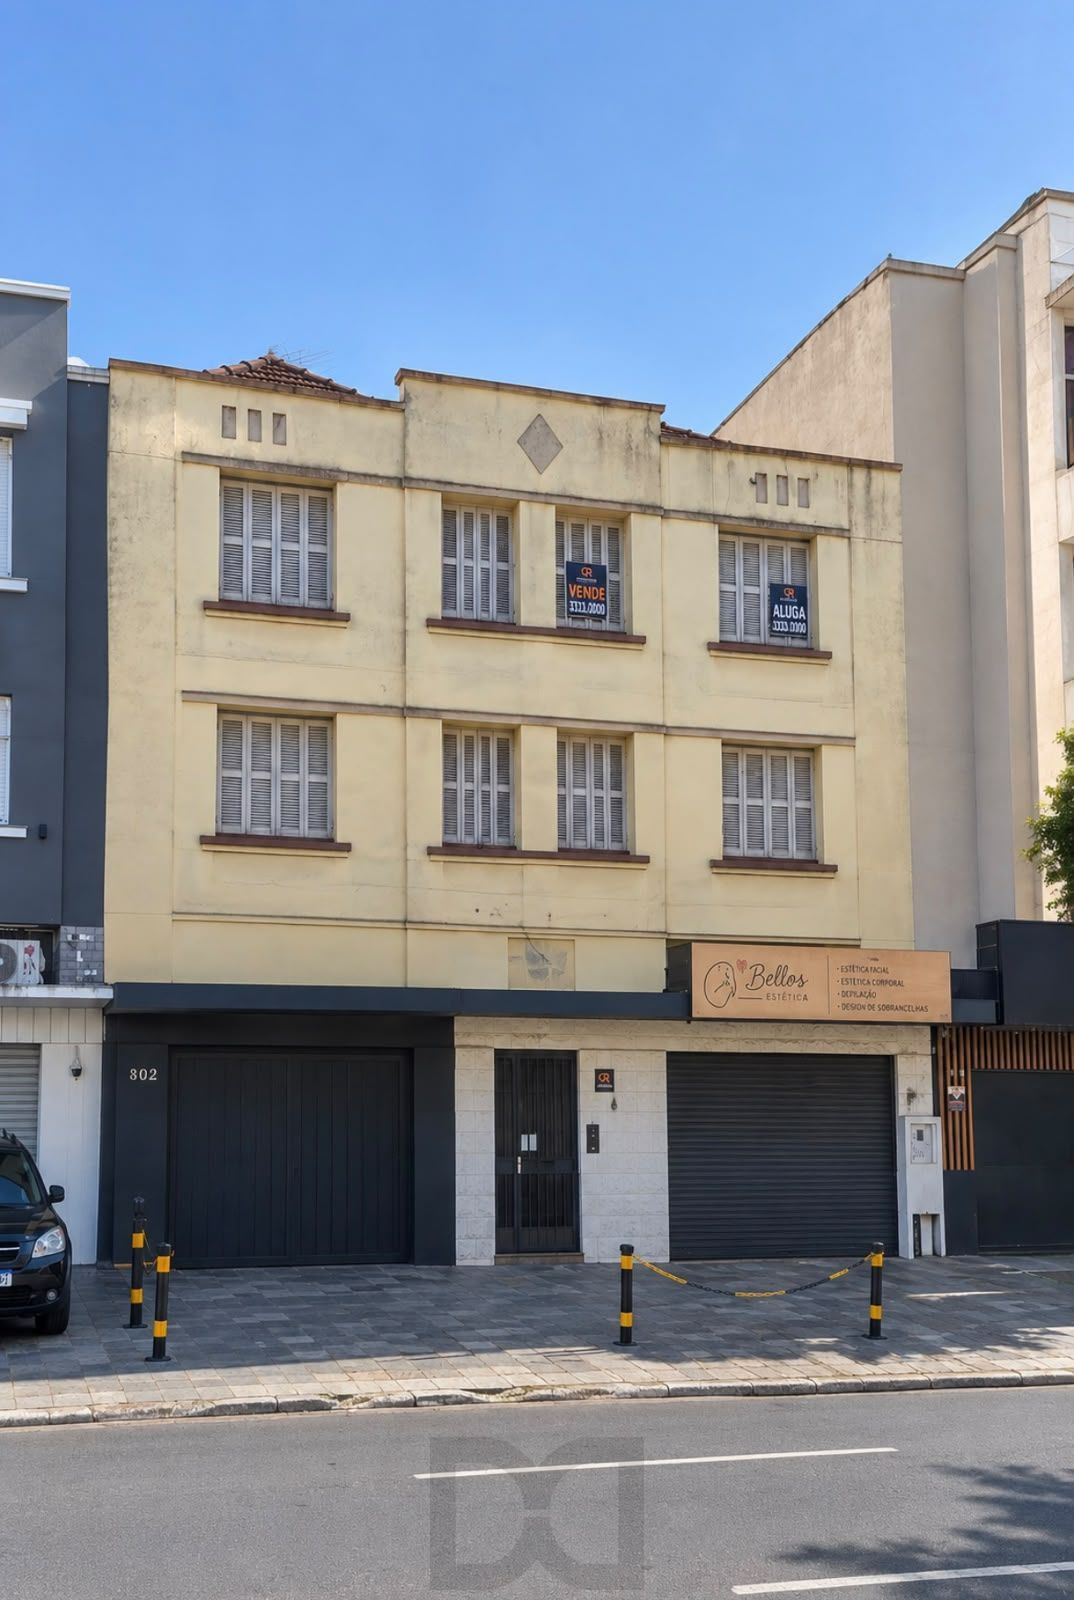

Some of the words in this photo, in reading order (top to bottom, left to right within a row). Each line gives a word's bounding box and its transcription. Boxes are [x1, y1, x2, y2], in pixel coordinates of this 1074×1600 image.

[568, 583, 606, 601] VENDE
[773, 604, 806, 620] ALUGA
[840, 964, 869, 974] ESTÉTICA
[869, 966, 890, 975] FACIAL
[745, 963, 809, 991] Bellos
[840, 977, 871, 987] ESTÉTICA
[872, 979, 904, 988] CORPORAL
[766, 991, 809, 1002] ESTÉTICA
[841, 989, 877, 1000] DEPILAÇÃO
[867, 1003, 876, 1012] DE
[877, 1003, 929, 1013] SOBRANCELHAS
[129, 1068, 157, 1081] 802
